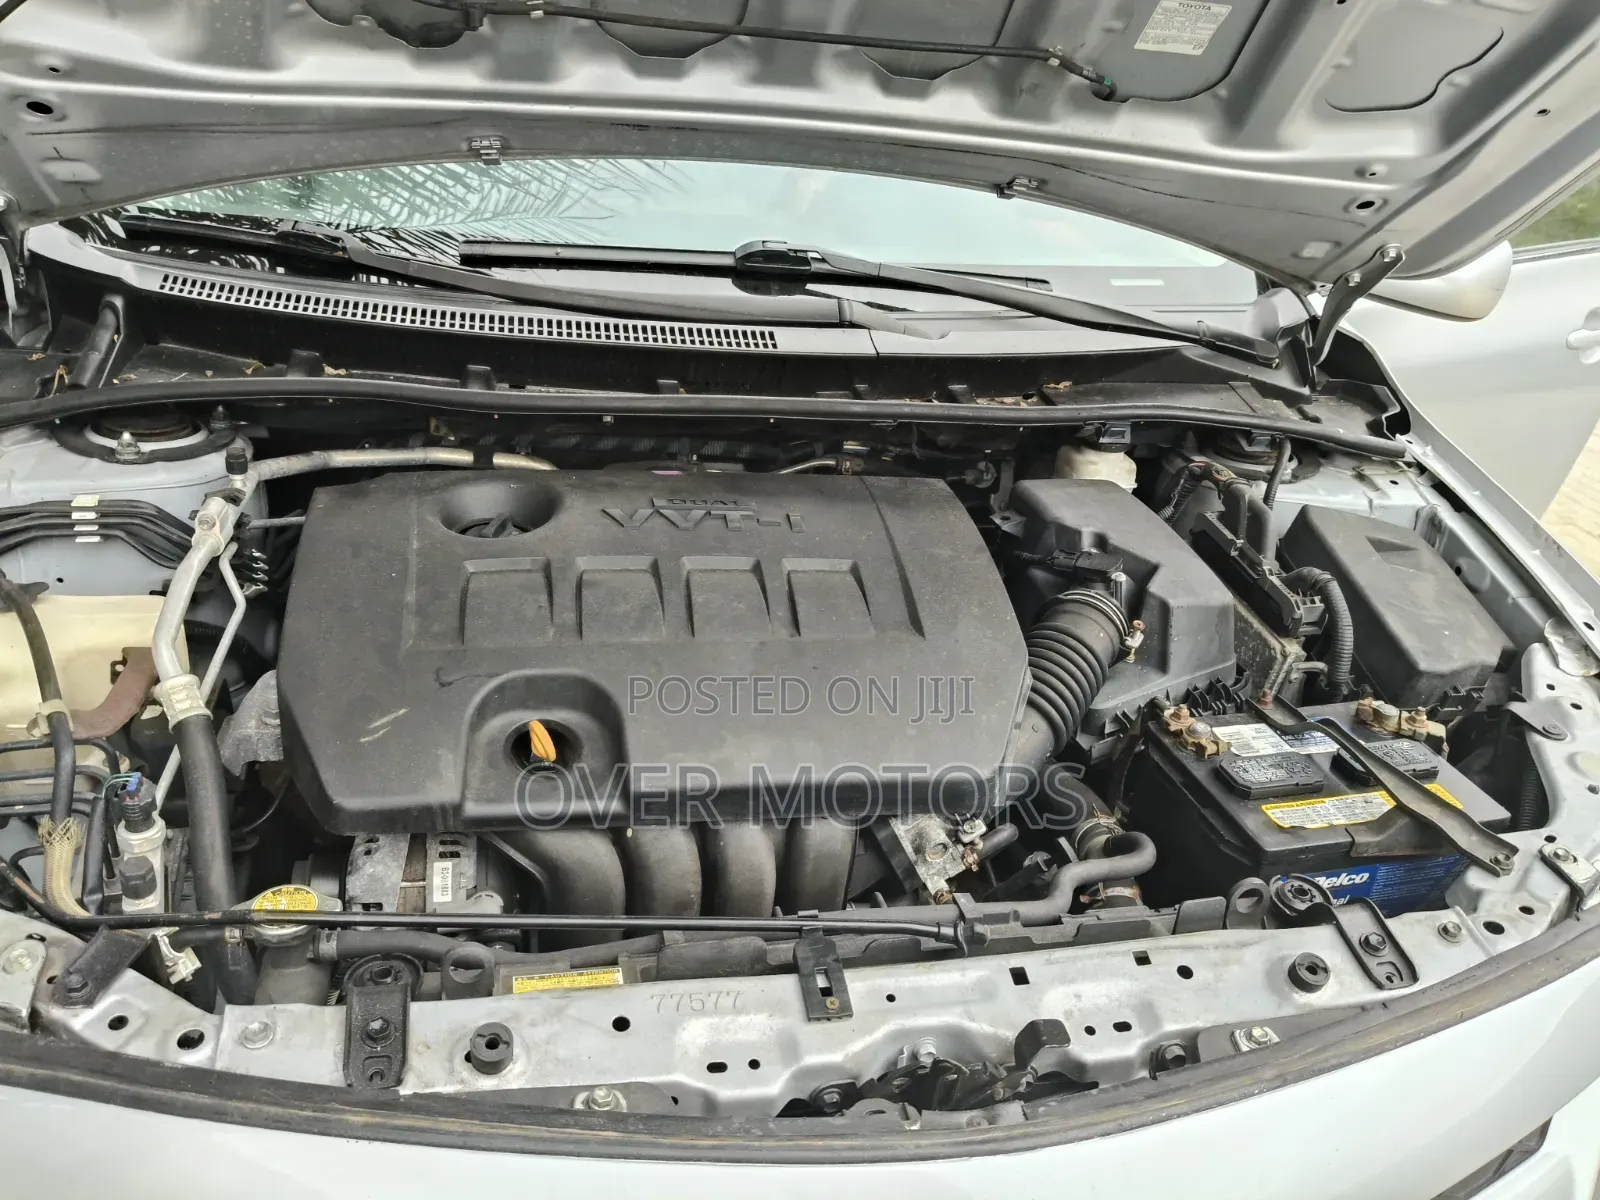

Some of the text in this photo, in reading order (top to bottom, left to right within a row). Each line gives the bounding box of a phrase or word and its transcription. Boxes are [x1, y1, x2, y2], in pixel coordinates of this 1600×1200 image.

[1178, 2, 1211, 11] TOYOTA
[583, 968, 619, 976] ATTENTION
[650, 991, 743, 1013] 77577
